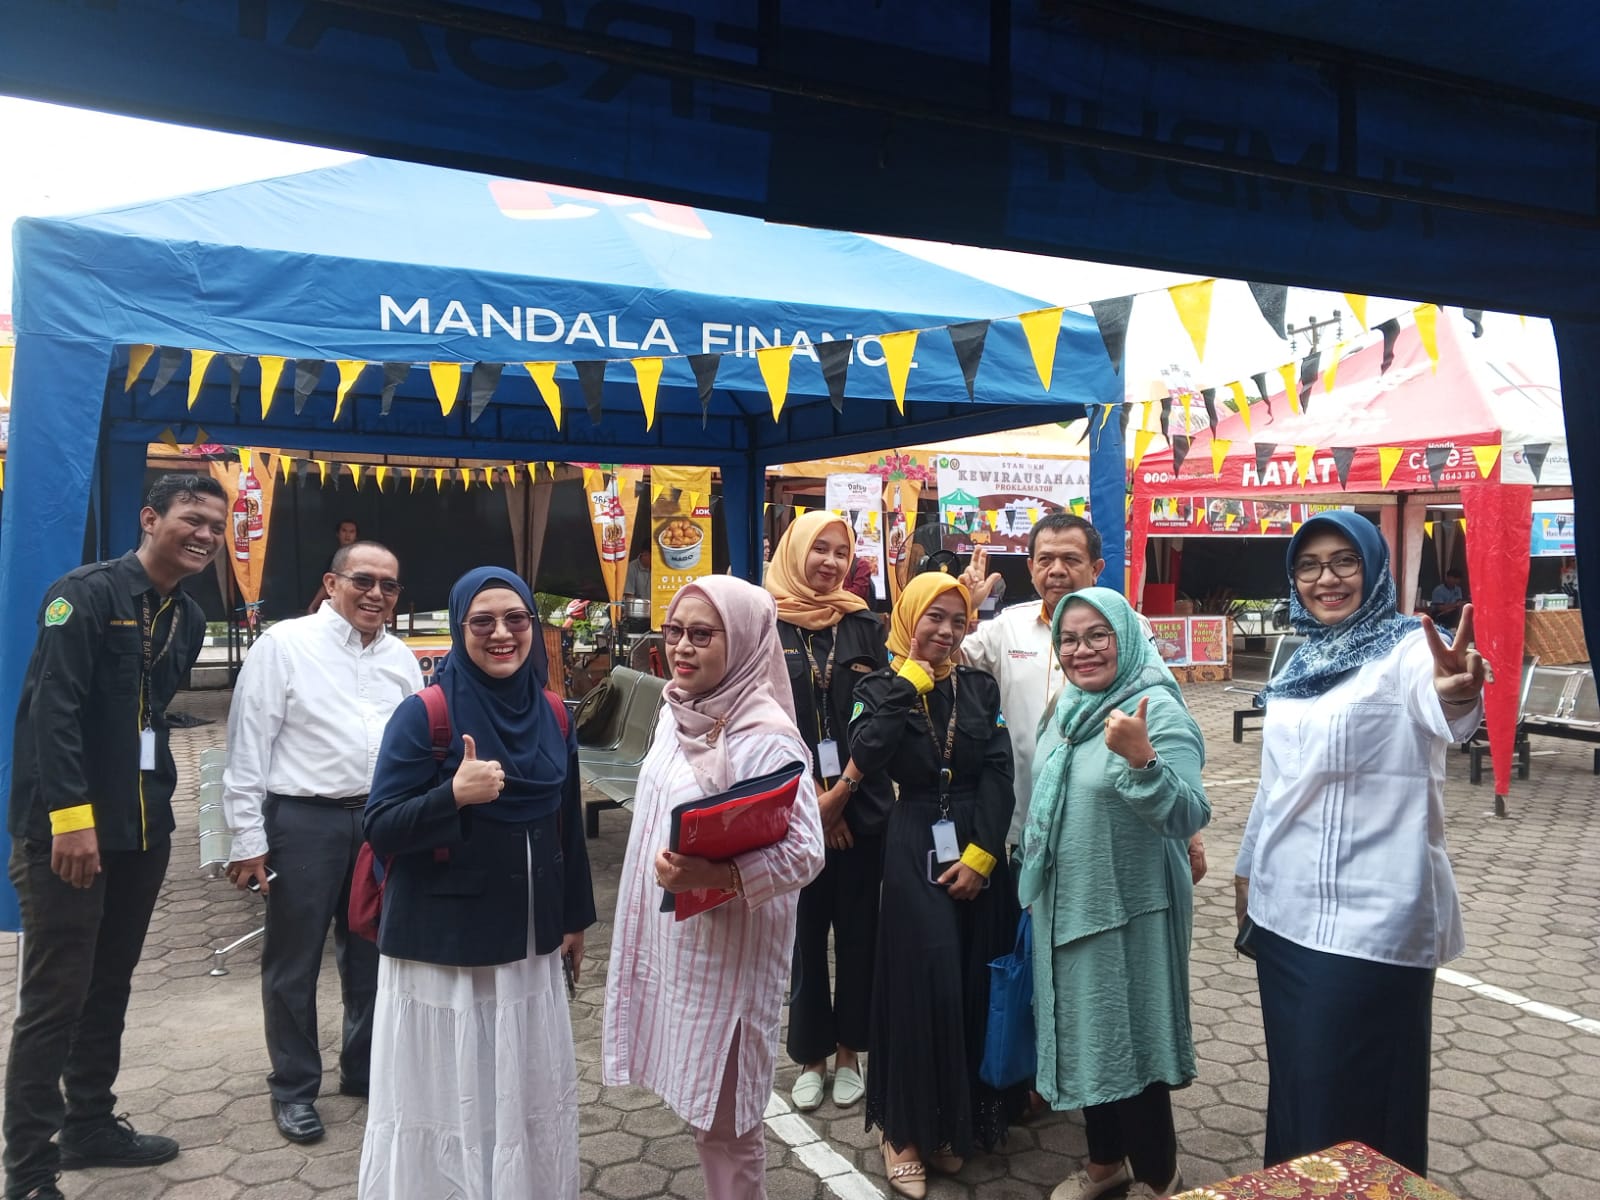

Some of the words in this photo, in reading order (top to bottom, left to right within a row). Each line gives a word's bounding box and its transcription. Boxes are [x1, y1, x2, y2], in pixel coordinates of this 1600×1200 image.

[379, 294, 679, 354] MANDALA
[702, 322, 918, 369] FINAC
[1240, 456, 1342, 487] HAYAT
[995, 484, 1053, 492] PROKLAMATOR
